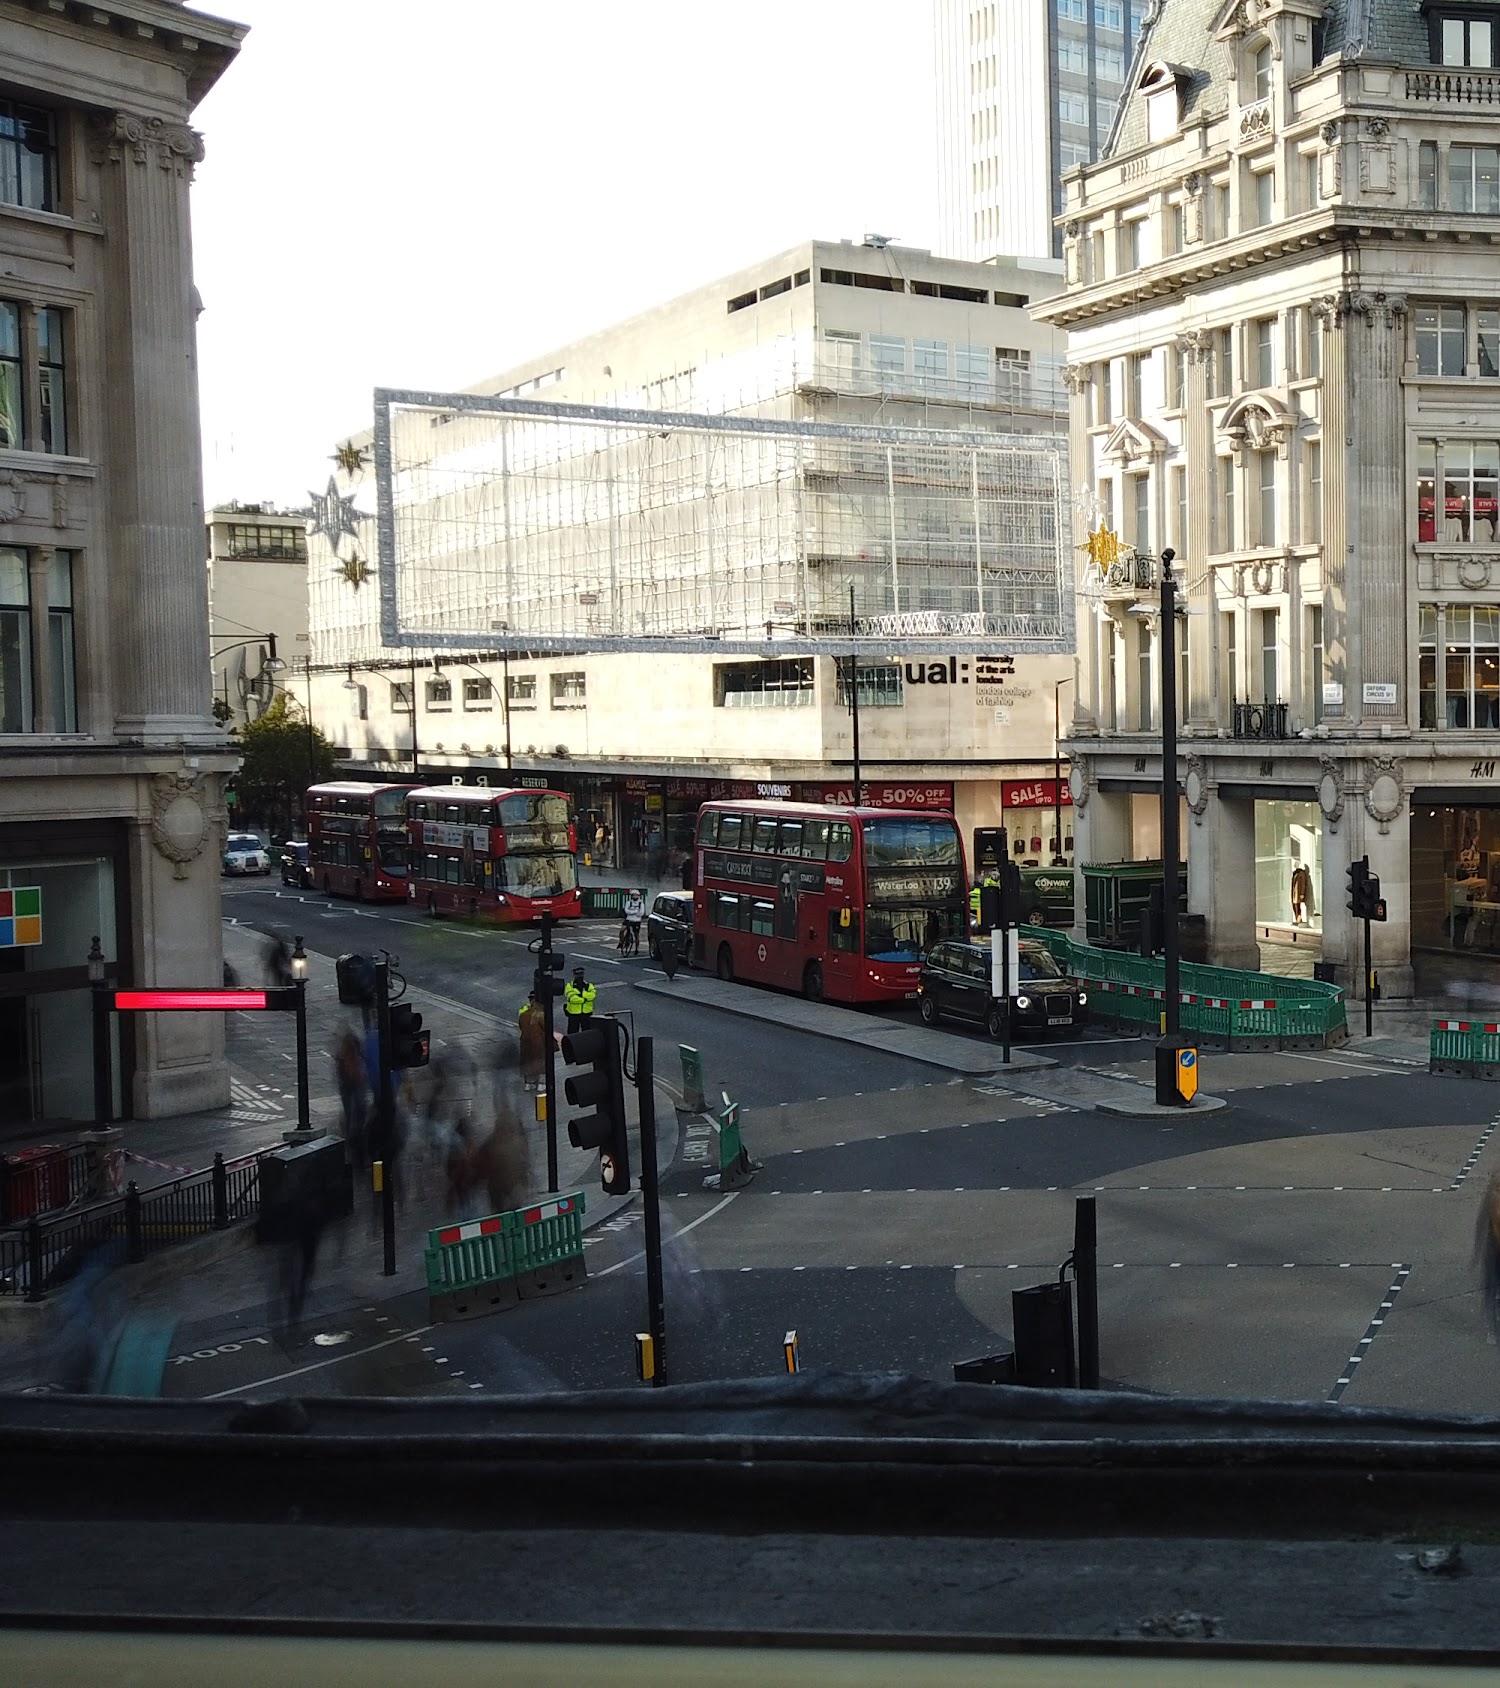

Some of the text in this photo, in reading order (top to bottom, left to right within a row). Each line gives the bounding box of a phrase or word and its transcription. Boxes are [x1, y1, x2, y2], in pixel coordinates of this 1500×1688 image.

[976, 655, 1014, 665] university
[905, 656, 968, 684] ual:
[976, 665, 1015, 674] of the arts
[976, 675, 1003, 684] london
[1470, 761, 1495, 778] H&M
[522, 777, 548, 788] RESERVED
[757, 783, 792, 797] SOUVENIRS
[882, 789, 925, 804] 50%
[925, 789, 945, 798] OFF
[1010, 784, 1044, 805] SALE
[877, 881, 919, 890] Waterloo
[933, 876, 951, 890] 139
[1034, 878, 1071, 891] CONWAY
[597, 1211, 645, 1232] LOOK
[167, 1337, 270, 1365] LOOK
